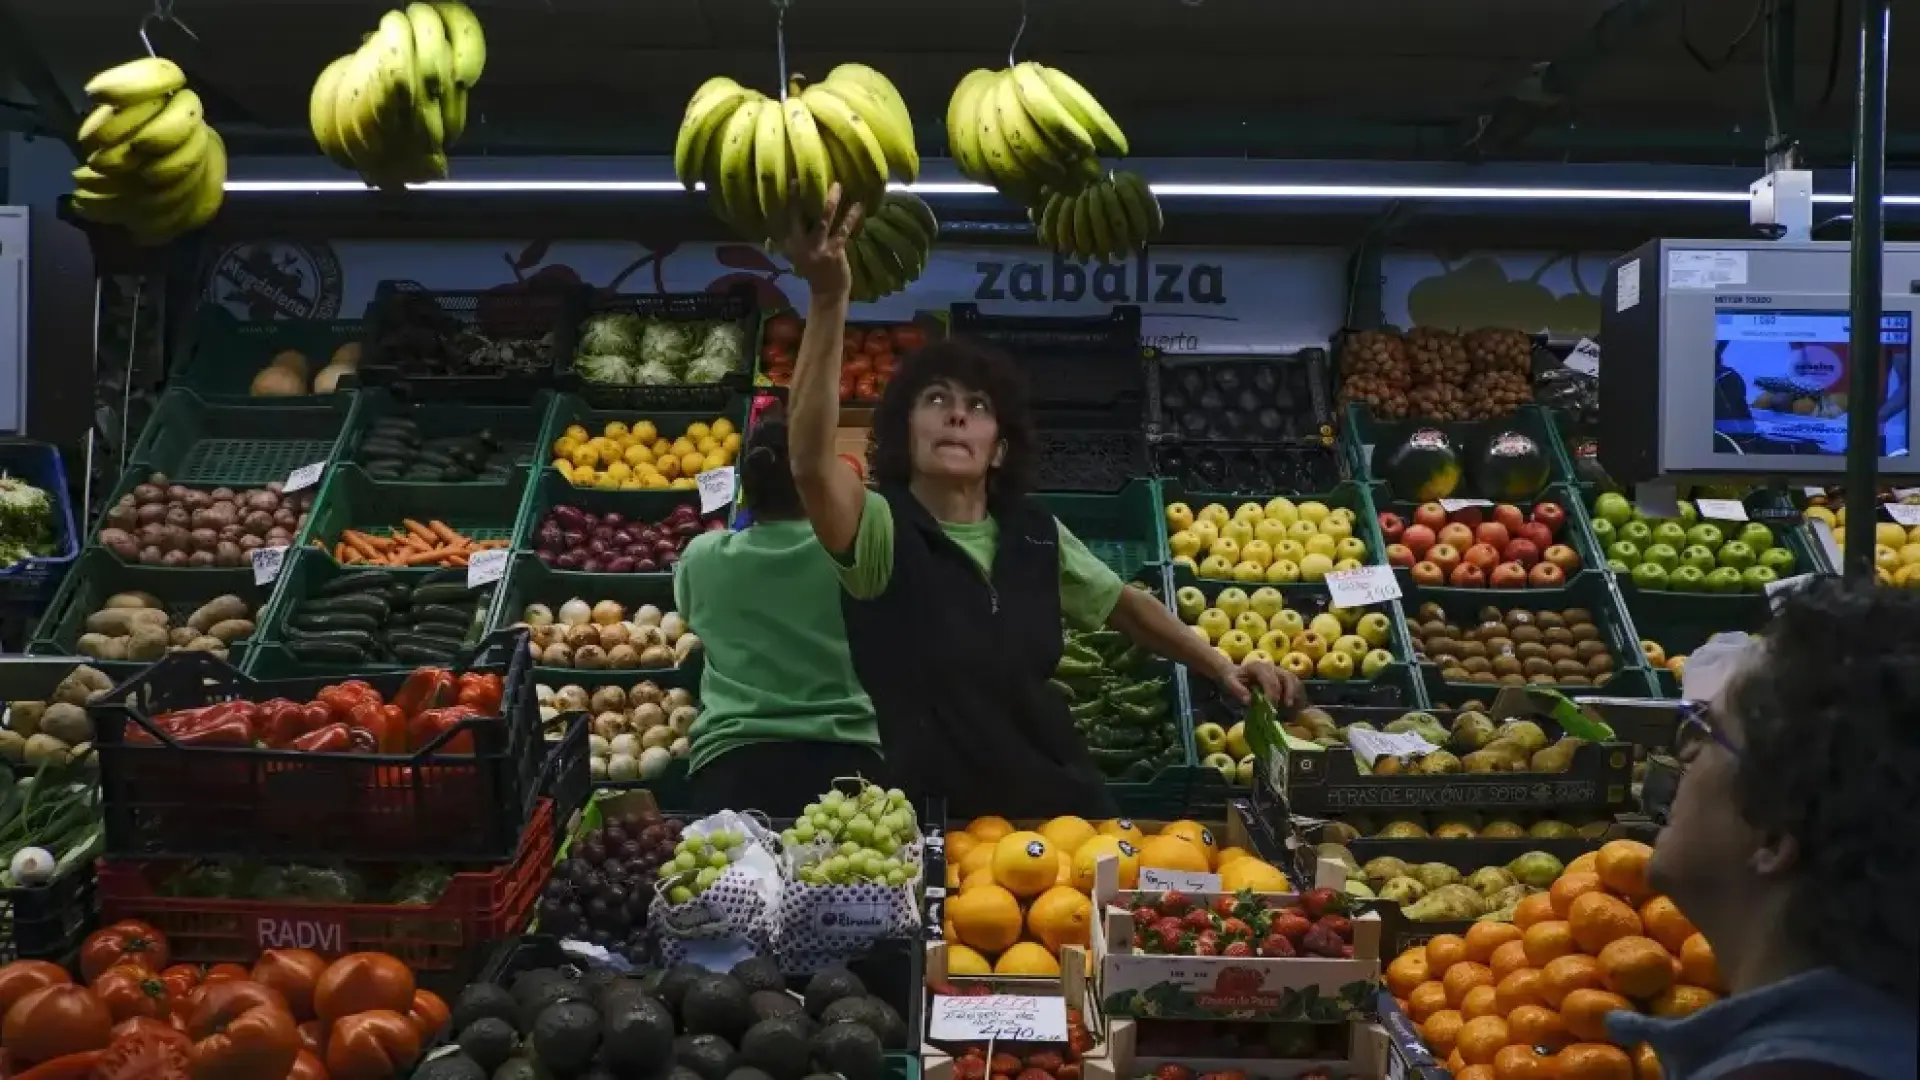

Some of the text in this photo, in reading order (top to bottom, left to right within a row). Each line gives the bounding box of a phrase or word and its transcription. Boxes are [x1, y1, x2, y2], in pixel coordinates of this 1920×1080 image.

[974, 249, 1226, 304] zabalza
[1142, 331, 1198, 350] uerta
[1327, 786, 1377, 804] PERAS
[1380, 786, 1401, 803] DE
[257, 918, 341, 952] RADVI
